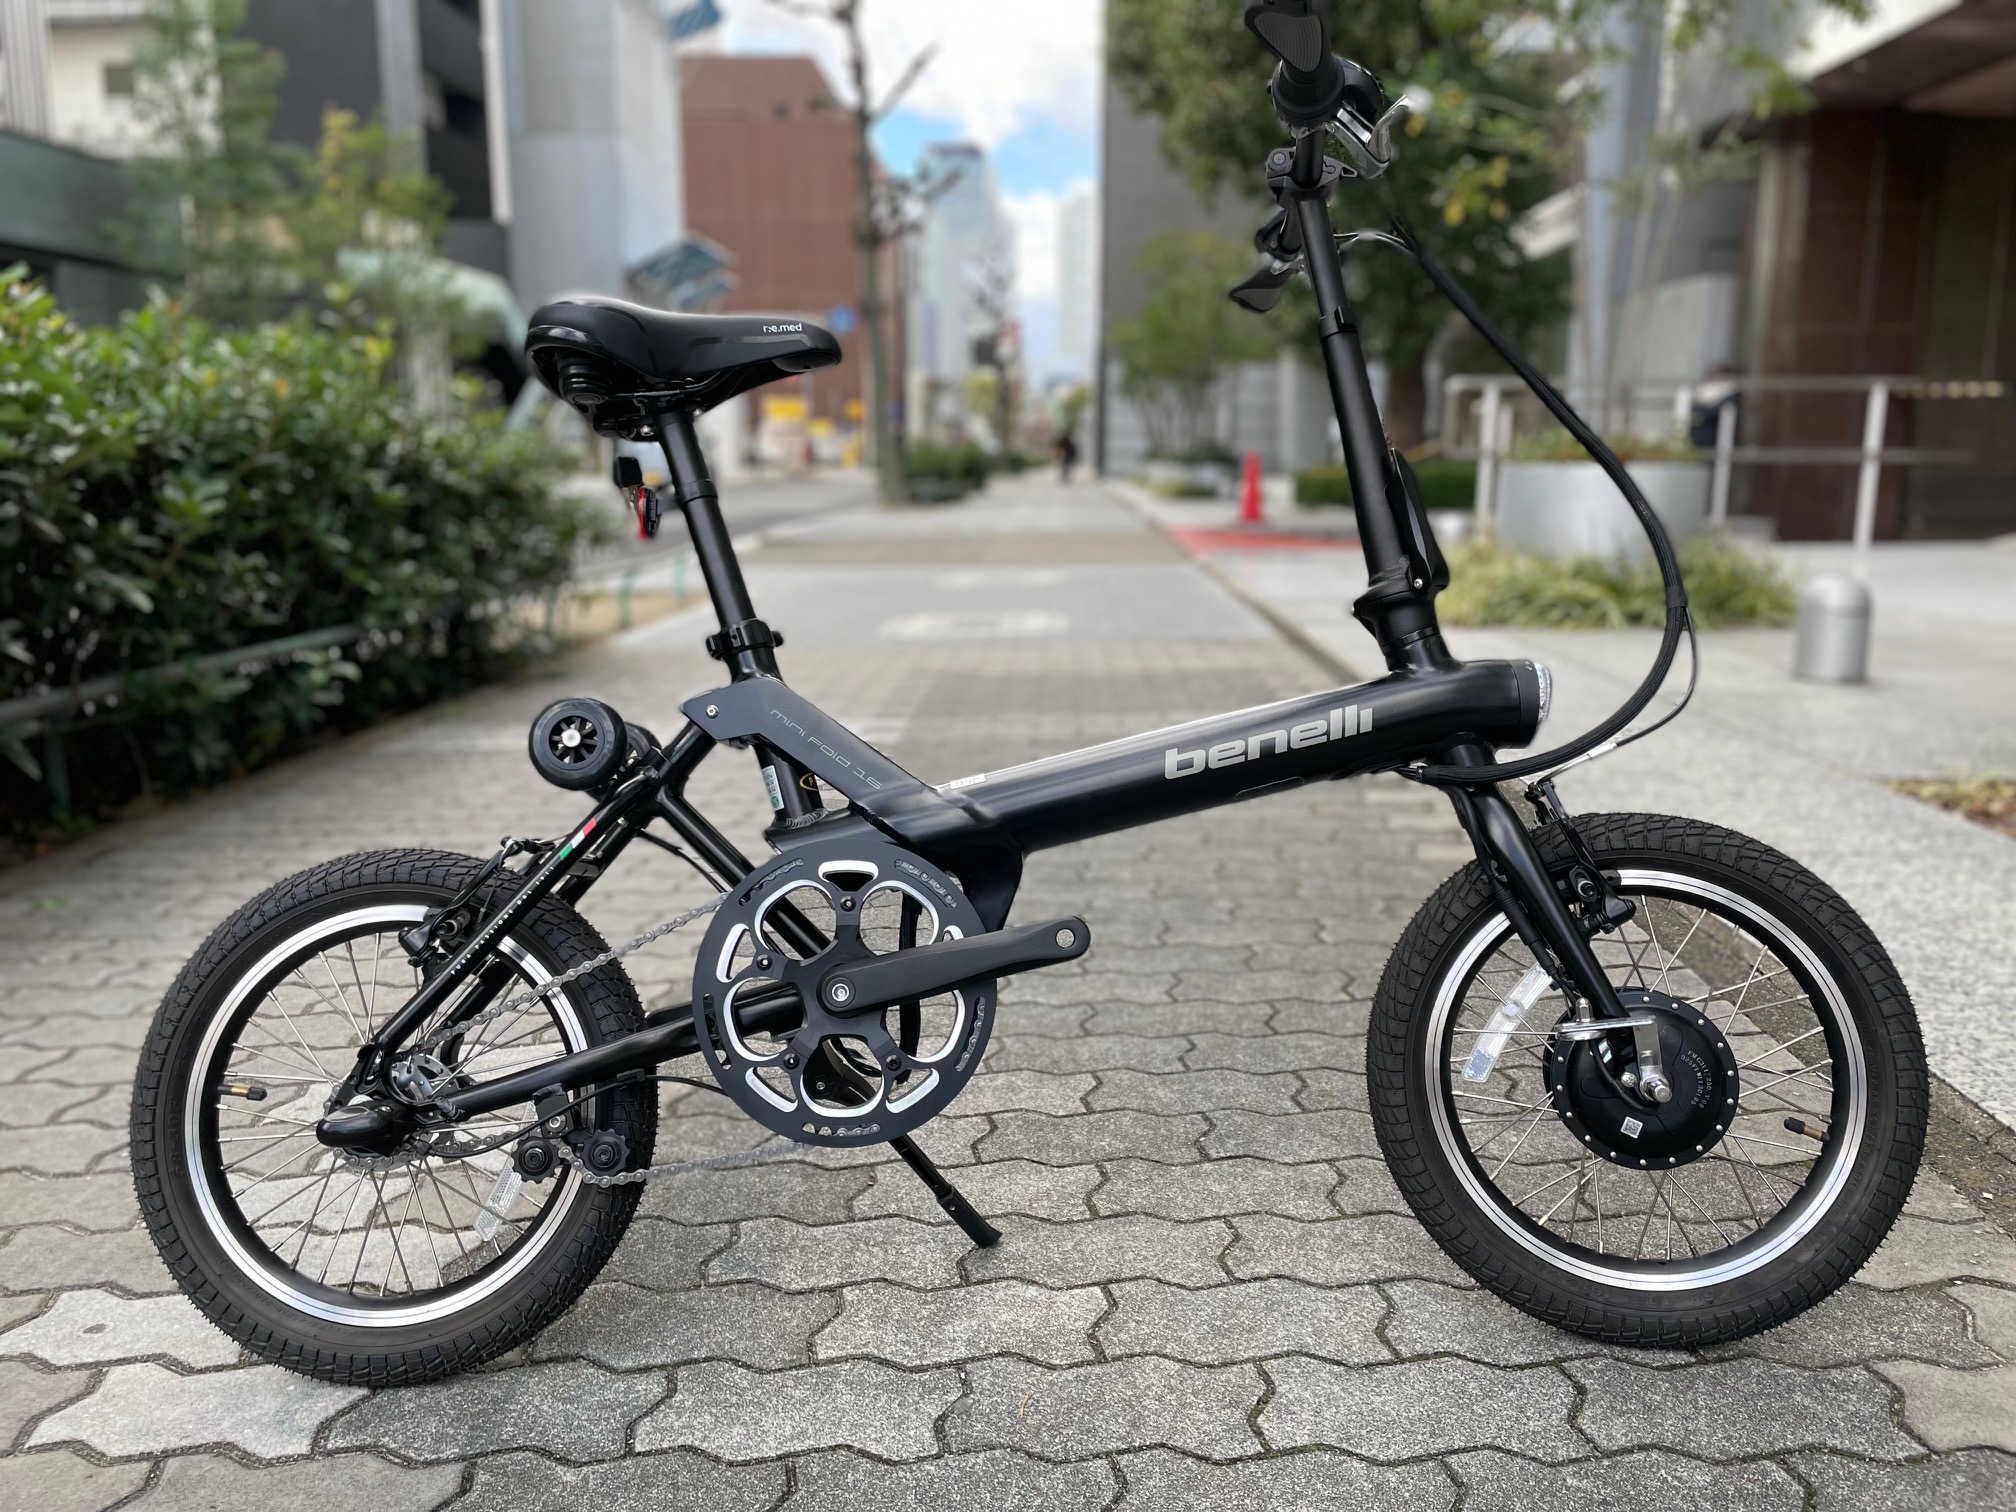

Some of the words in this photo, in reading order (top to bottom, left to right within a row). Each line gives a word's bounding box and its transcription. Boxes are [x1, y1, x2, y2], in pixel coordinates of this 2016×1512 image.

[770, 709, 807, 737] mini
[852, 766, 882, 790] 16
[1164, 704, 1373, 780] benelli
[474, 908, 514, 950] PASSIONE
[516, 890, 532, 905] DAL
[535, 866, 554, 885] 1911
